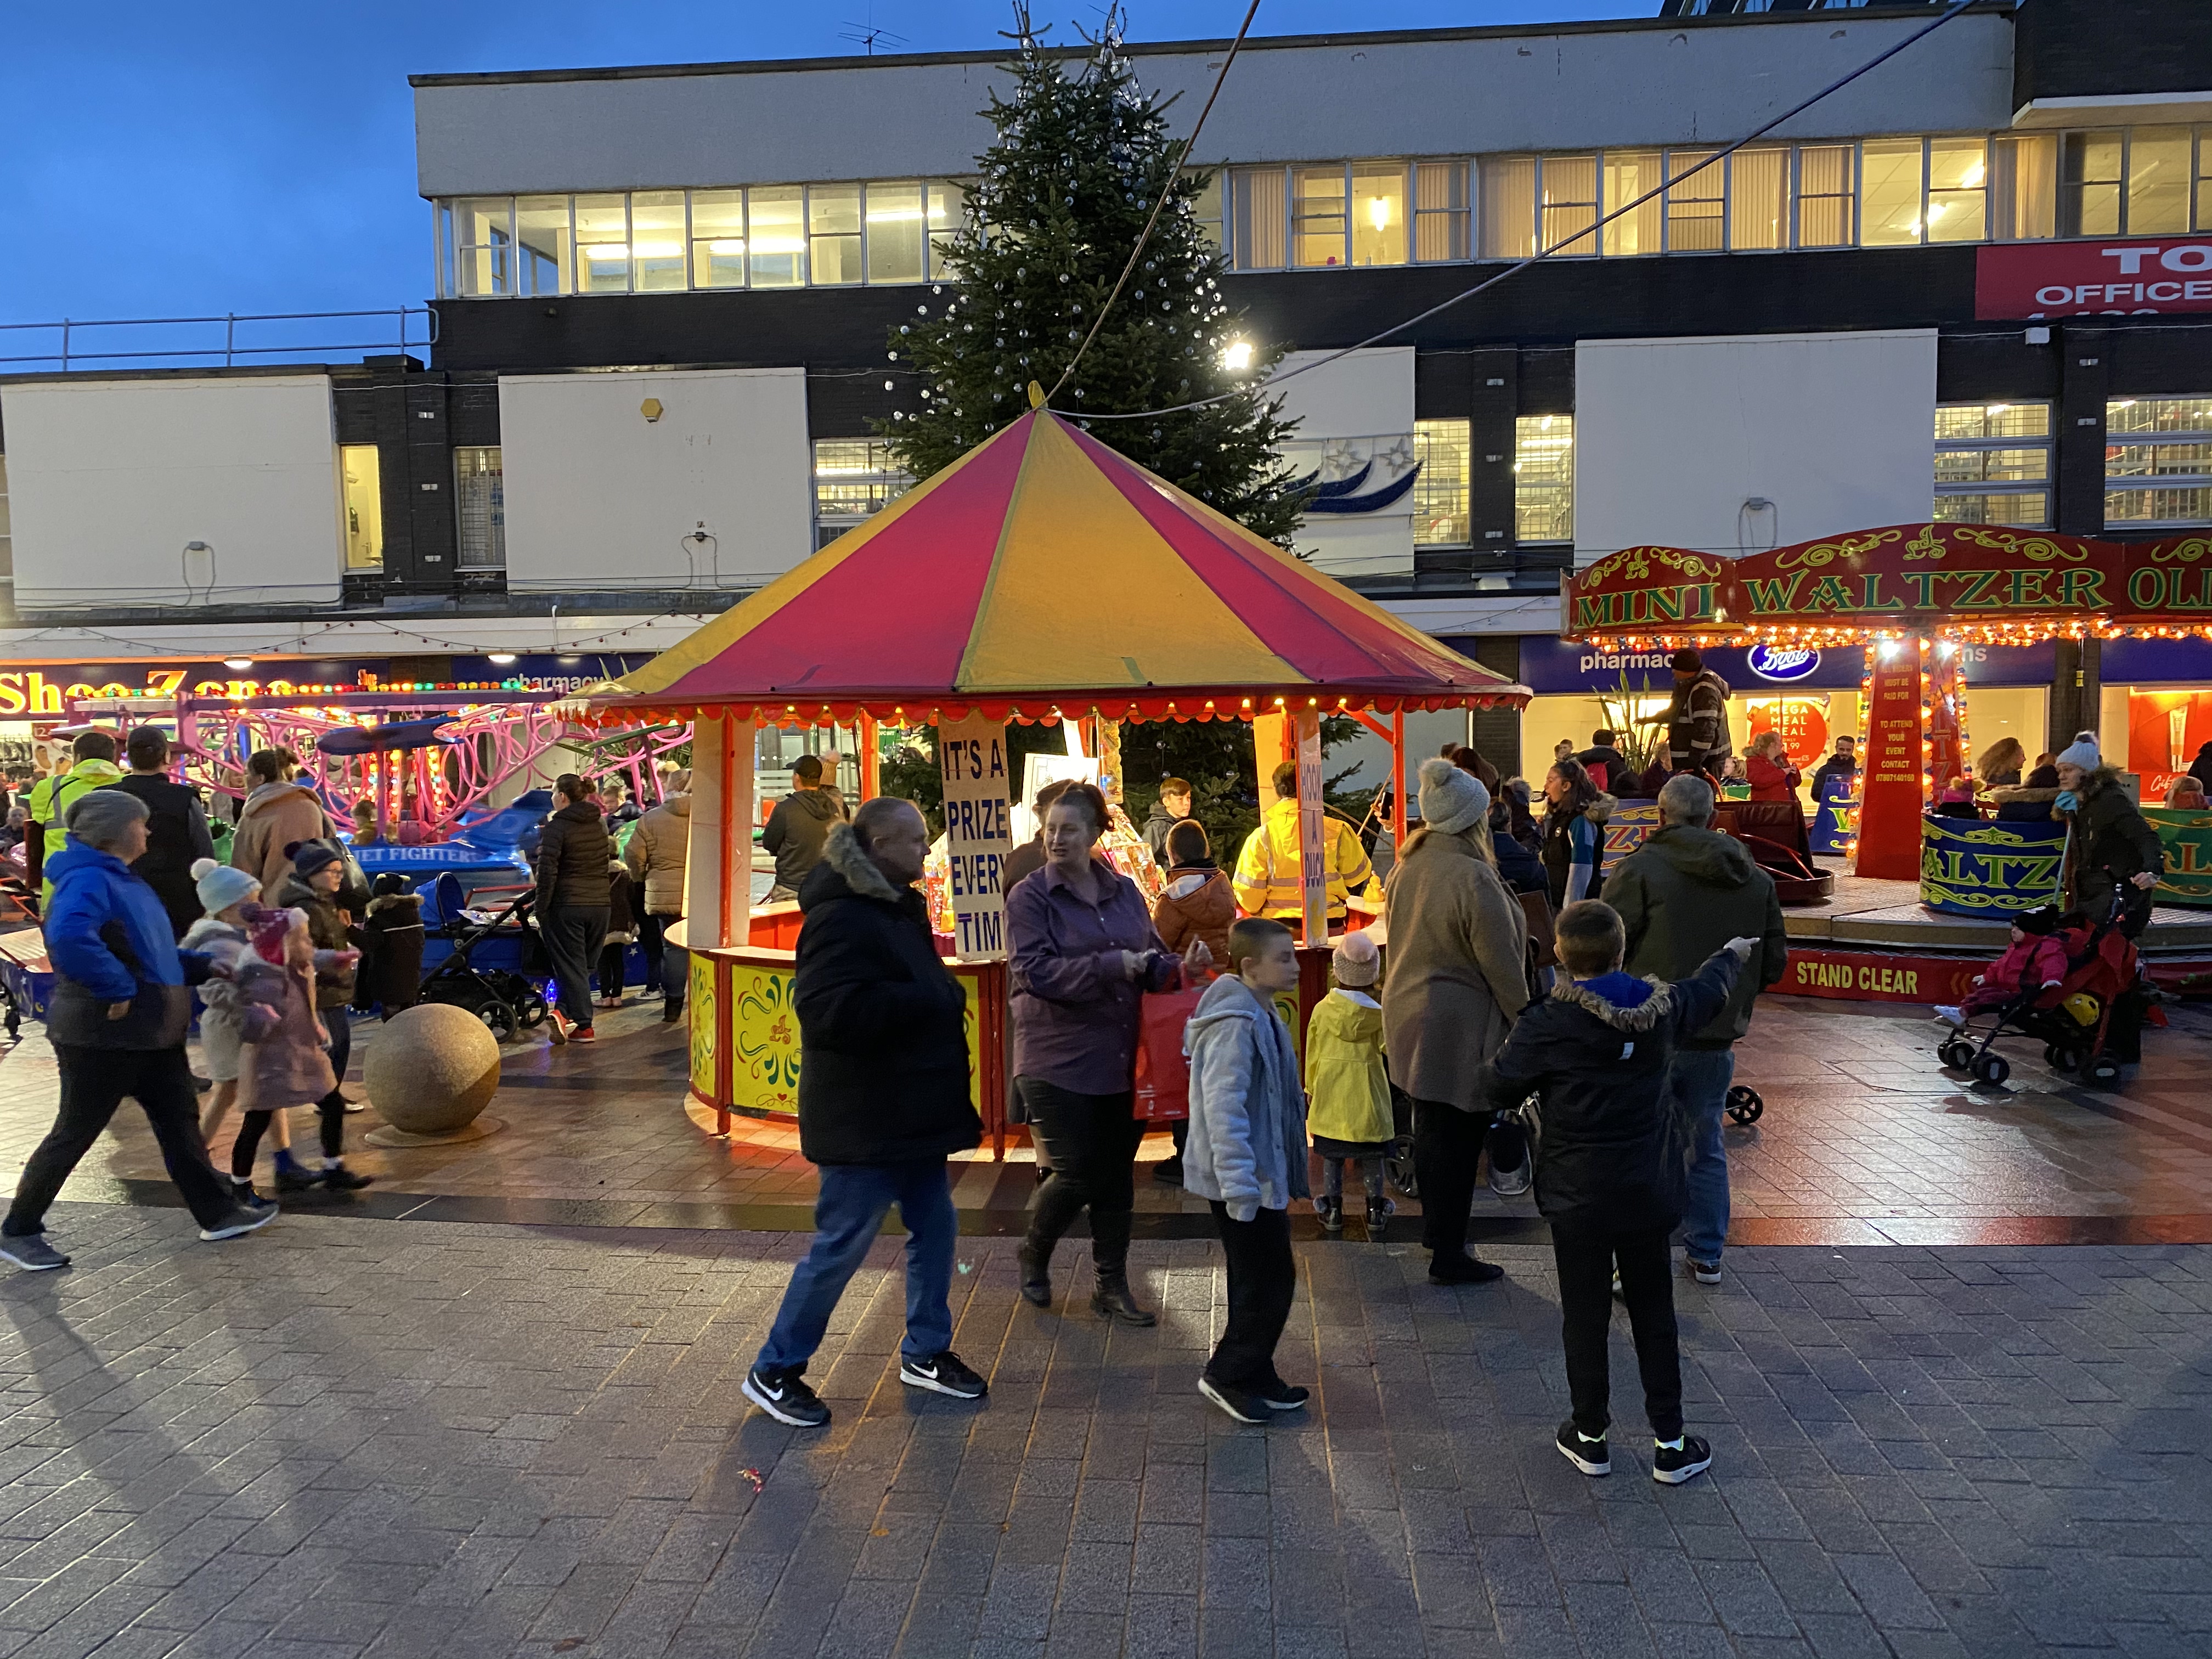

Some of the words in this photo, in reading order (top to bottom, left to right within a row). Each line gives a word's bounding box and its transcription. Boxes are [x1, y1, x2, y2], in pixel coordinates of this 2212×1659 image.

[1573, 582, 1722, 629] MINI
[1740, 568, 2113, 614] WALTZER
[1580, 651, 1673, 673] pharmac
[1758, 647, 1816, 671] Boots
[1769, 705, 1808, 715] MEGA
[1771, 716, 1808, 725] MEAL
[1772, 727, 1806, 736] DEAL
[1888, 733, 1905, 742] YOUR
[944, 740, 982, 780] IT'S
[990, 738, 1005, 778] A
[1881, 760, 1910, 769] CONTACT
[1300, 763, 1323, 802] HOOK
[947, 798, 1008, 841] PRIZE
[1311, 810, 1318, 844] A
[951, 853, 1011, 896] EVERY
[1305, 852, 1326, 888] DUCK
[1921, 847, 2065, 889] ALTZ
[957, 911, 1005, 952] TIM
[1797, 961, 1853, 989] STAND
[1858, 966, 1918, 995] CLEAR
